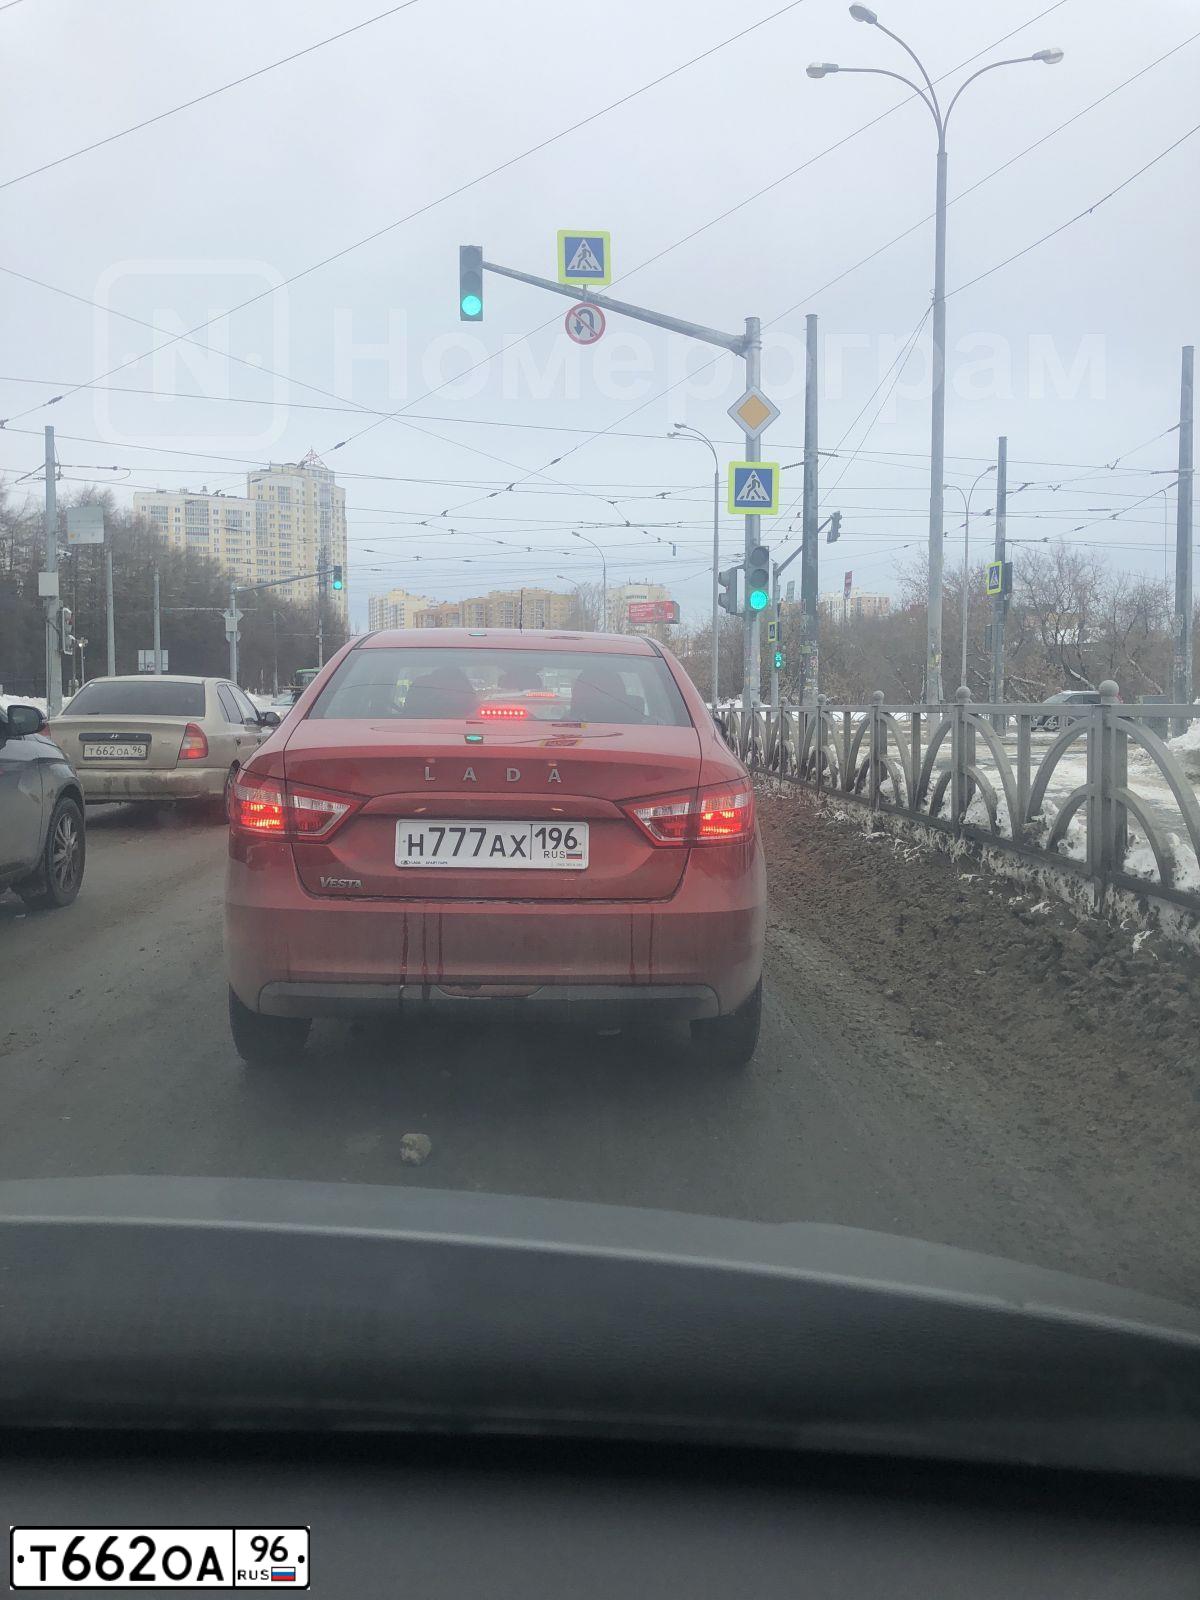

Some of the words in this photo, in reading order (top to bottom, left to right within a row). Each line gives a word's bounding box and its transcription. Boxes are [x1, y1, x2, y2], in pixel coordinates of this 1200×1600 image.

[89, 746, 129, 756] Т662ОА
[132, 745, 142, 753] 96
[424, 766, 562, 783] LADA
[407, 827, 527, 857] Н777АХ
[535, 827, 578, 850] 196
[543, 850, 566, 859] RUS
